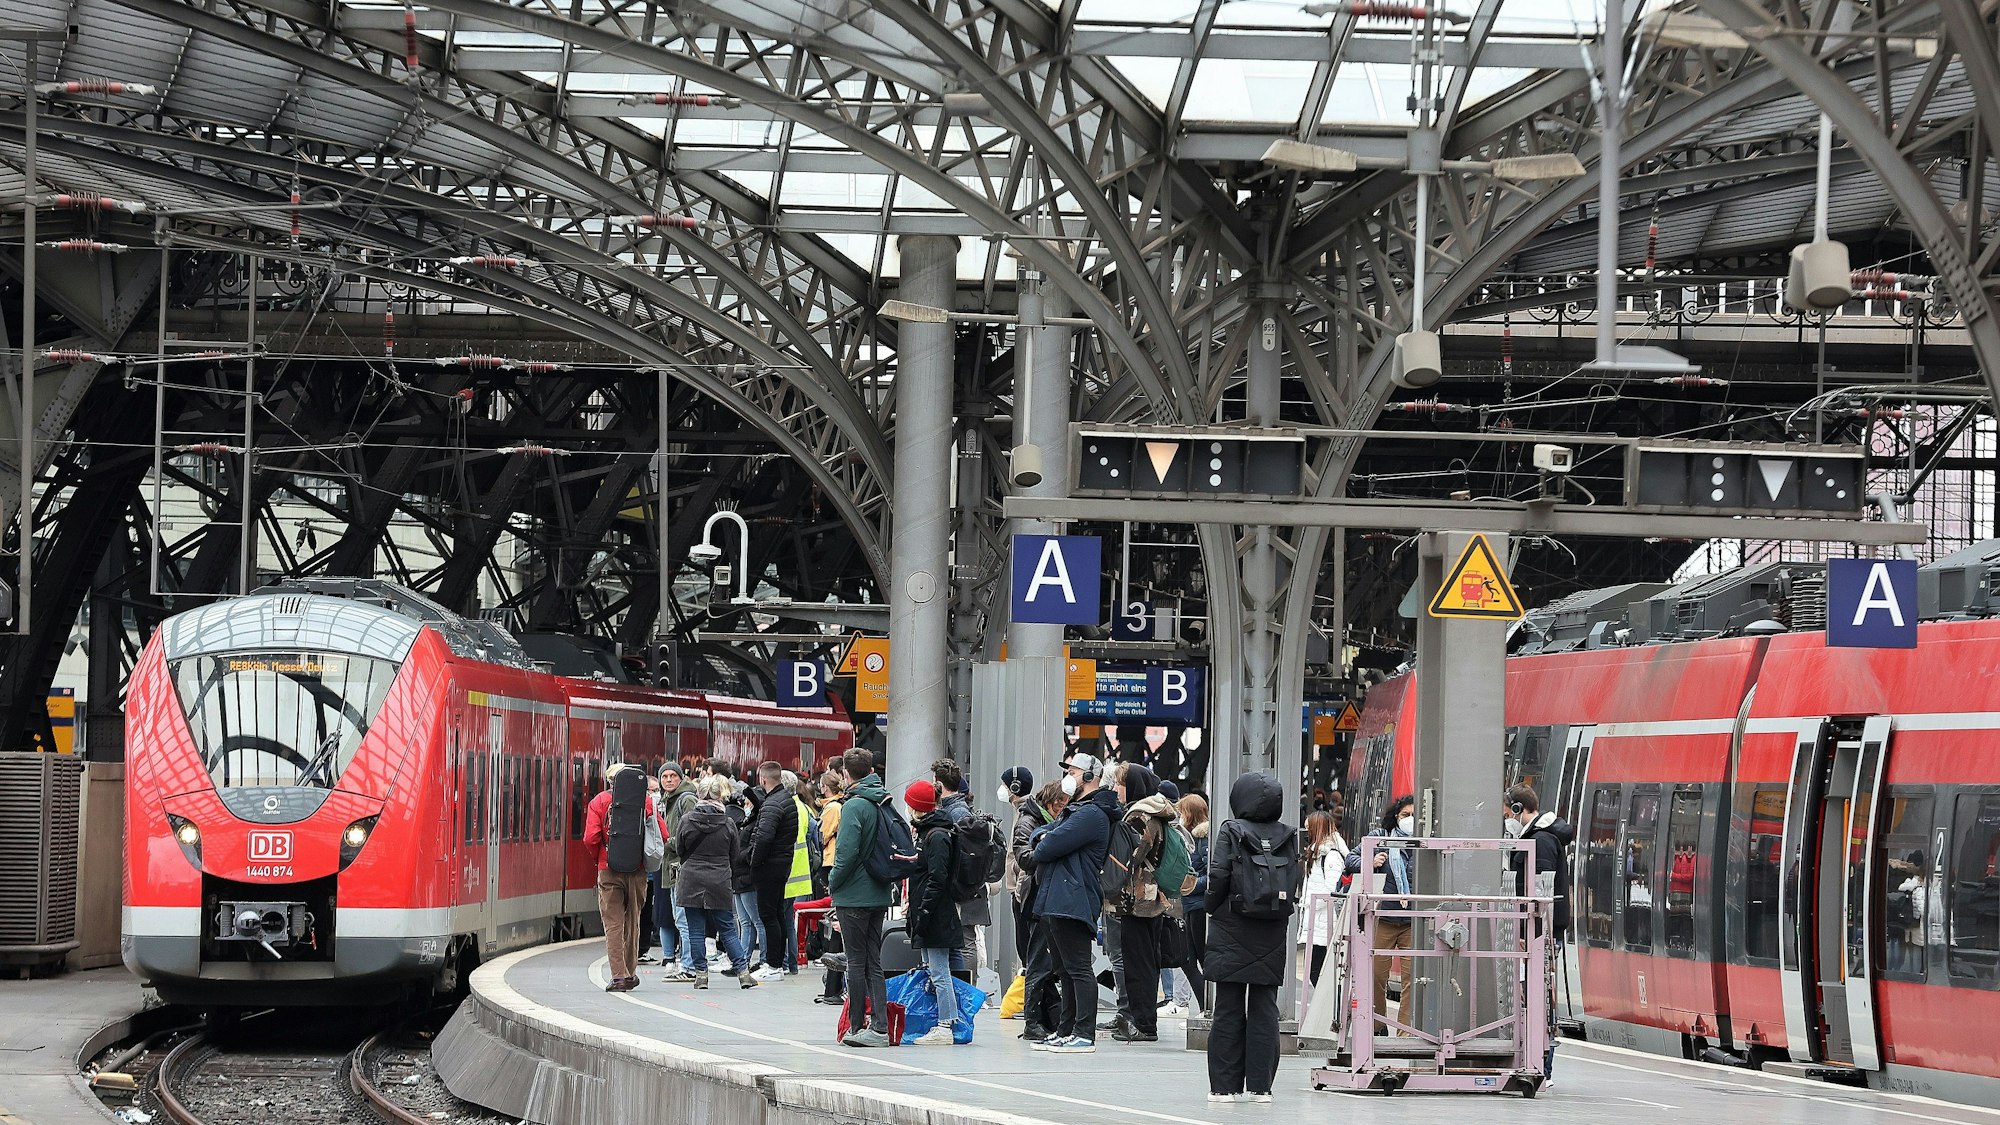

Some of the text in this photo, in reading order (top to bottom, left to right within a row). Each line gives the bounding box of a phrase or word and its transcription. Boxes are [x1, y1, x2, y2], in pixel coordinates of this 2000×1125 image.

[1024, 539, 1076, 603] A
[1851, 562, 1905, 627] A
[1126, 601, 1147, 632] 3
[793, 661, 818, 697] B
[1110, 684, 1128, 692] nicht
[1162, 669, 1188, 705] B
[253, 835, 287, 856] DB
[1935, 831, 1944, 871] 2
[246, 865, 294, 877] 1440 874
